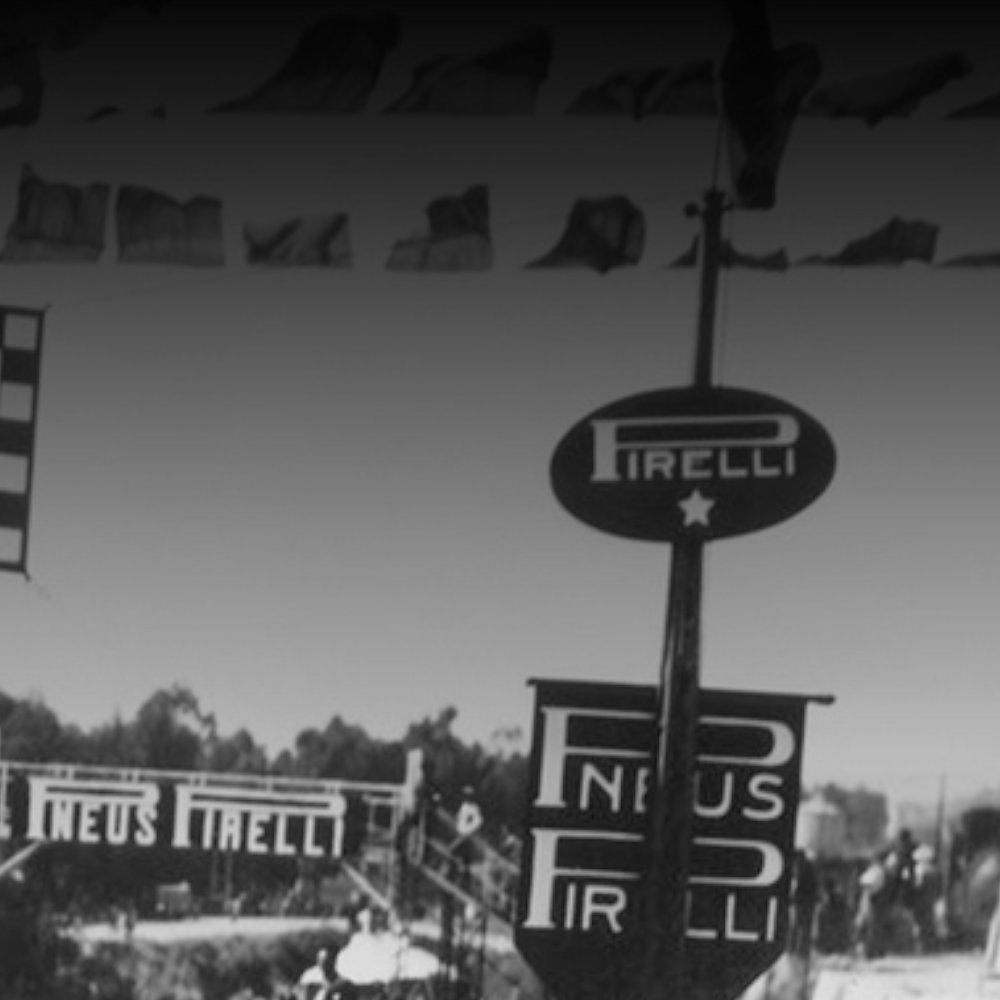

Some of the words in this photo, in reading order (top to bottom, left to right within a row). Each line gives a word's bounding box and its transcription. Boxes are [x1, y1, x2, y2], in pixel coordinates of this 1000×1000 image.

[590, 413, 800, 482] PIRELLI
[26, 776, 160, 847] PNEUS
[171, 784, 347, 858] PIRELLI
[522, 827, 786, 943] PIRLLI
